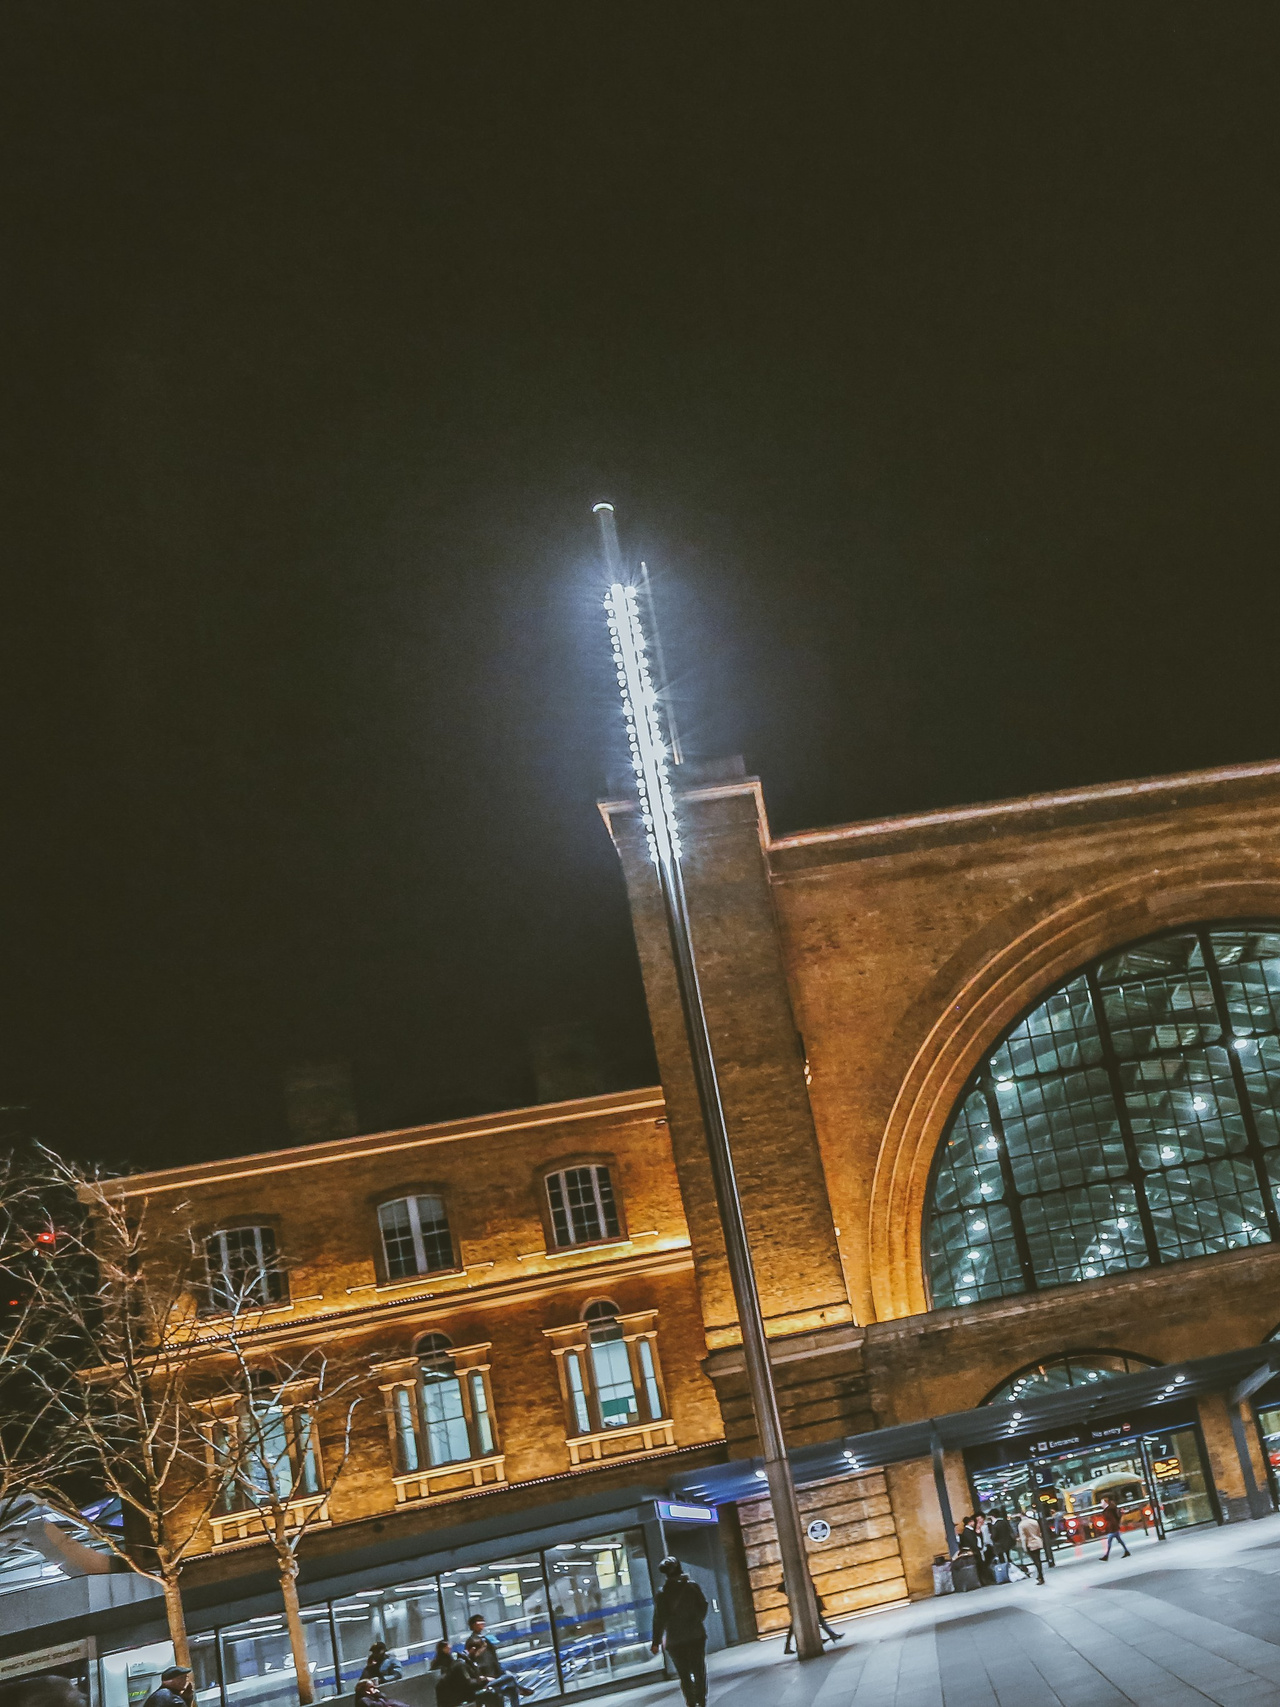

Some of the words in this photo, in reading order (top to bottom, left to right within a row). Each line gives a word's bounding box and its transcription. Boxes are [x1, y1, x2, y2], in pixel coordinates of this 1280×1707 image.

[1091, 1430, 1103, 1438] No
[1103, 1427, 1121, 1436] entry
[1049, 1436, 1080, 1449] Entrance
